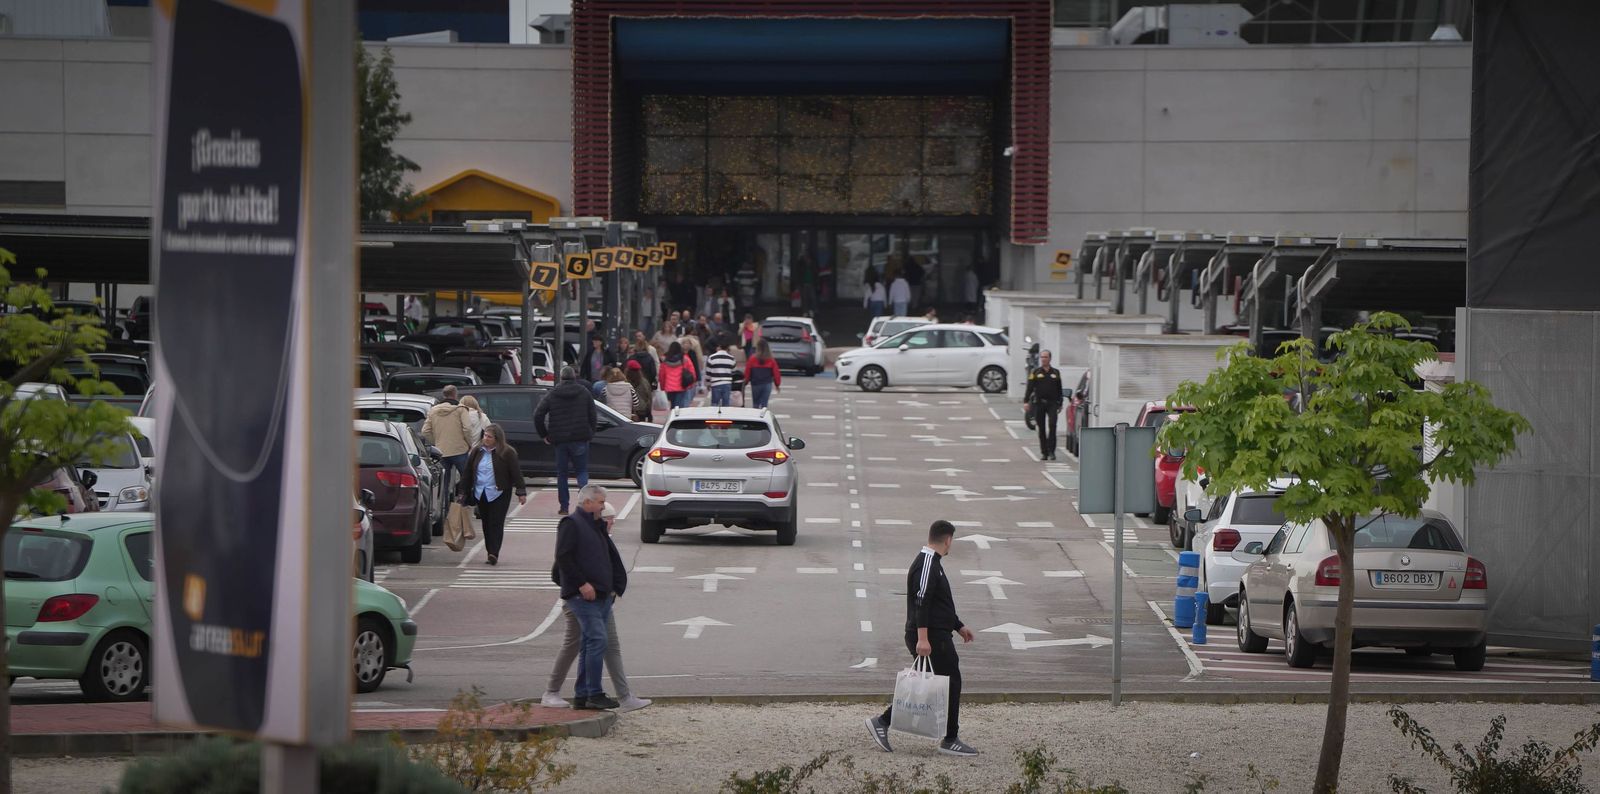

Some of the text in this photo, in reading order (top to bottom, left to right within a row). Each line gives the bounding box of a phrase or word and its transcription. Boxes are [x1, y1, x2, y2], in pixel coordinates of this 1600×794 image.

[651, 251, 659, 261] 2
[665, 246, 671, 255] 1
[599, 254, 608, 266] 5
[618, 252, 628, 263] 4
[635, 255, 644, 266] 3
[572, 260, 584, 273] 6
[539, 269, 550, 283] 7
[701, 482, 738, 490] 8475 JZS
[1383, 573, 1433, 584] 8602 DBX
